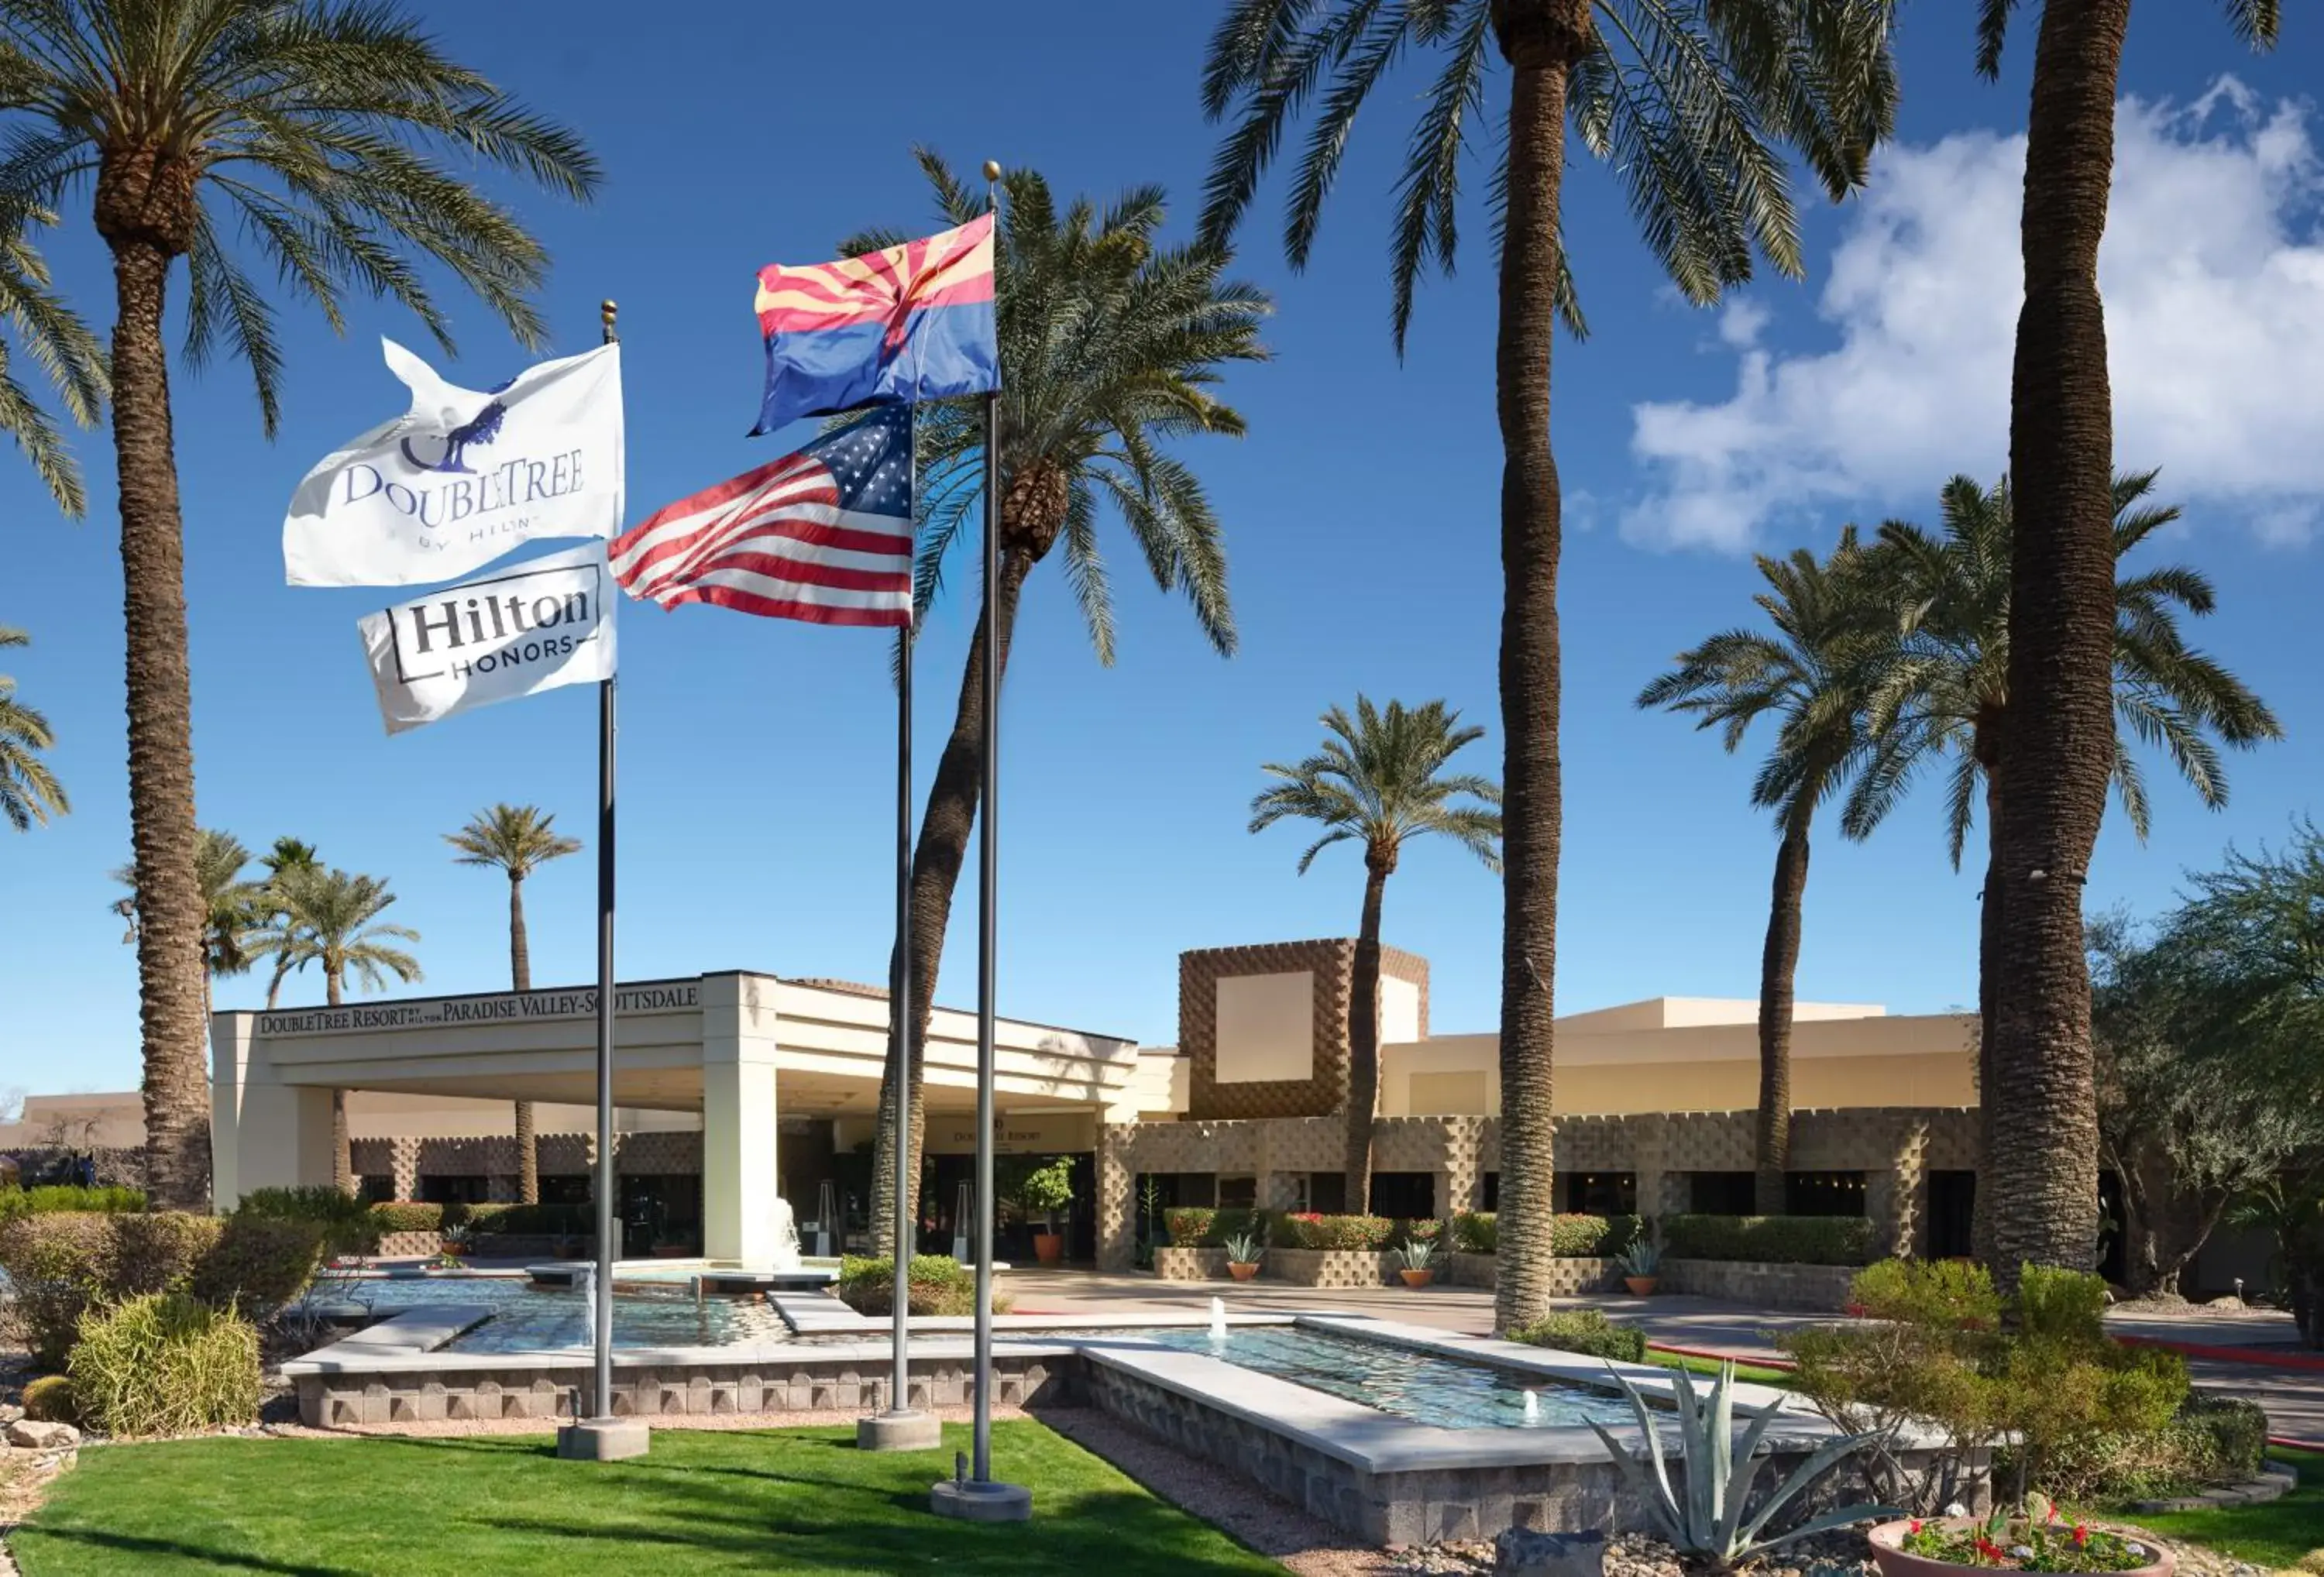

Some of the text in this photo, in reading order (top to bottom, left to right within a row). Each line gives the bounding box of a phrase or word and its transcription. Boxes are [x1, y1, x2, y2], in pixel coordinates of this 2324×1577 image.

[469, 517, 530, 543] HILN
[408, 591, 588, 654] Hilton
[451, 635, 573, 680] HONORS
[260, 1012, 349, 1034] DOUBLETREE
[352, 1008, 407, 1029] RESORT
[408, 1015, 442, 1024] HILTON
[442, 1000, 517, 1022] PARADISE
[518, 988, 698, 1017] VALLEY-STTSDALE
